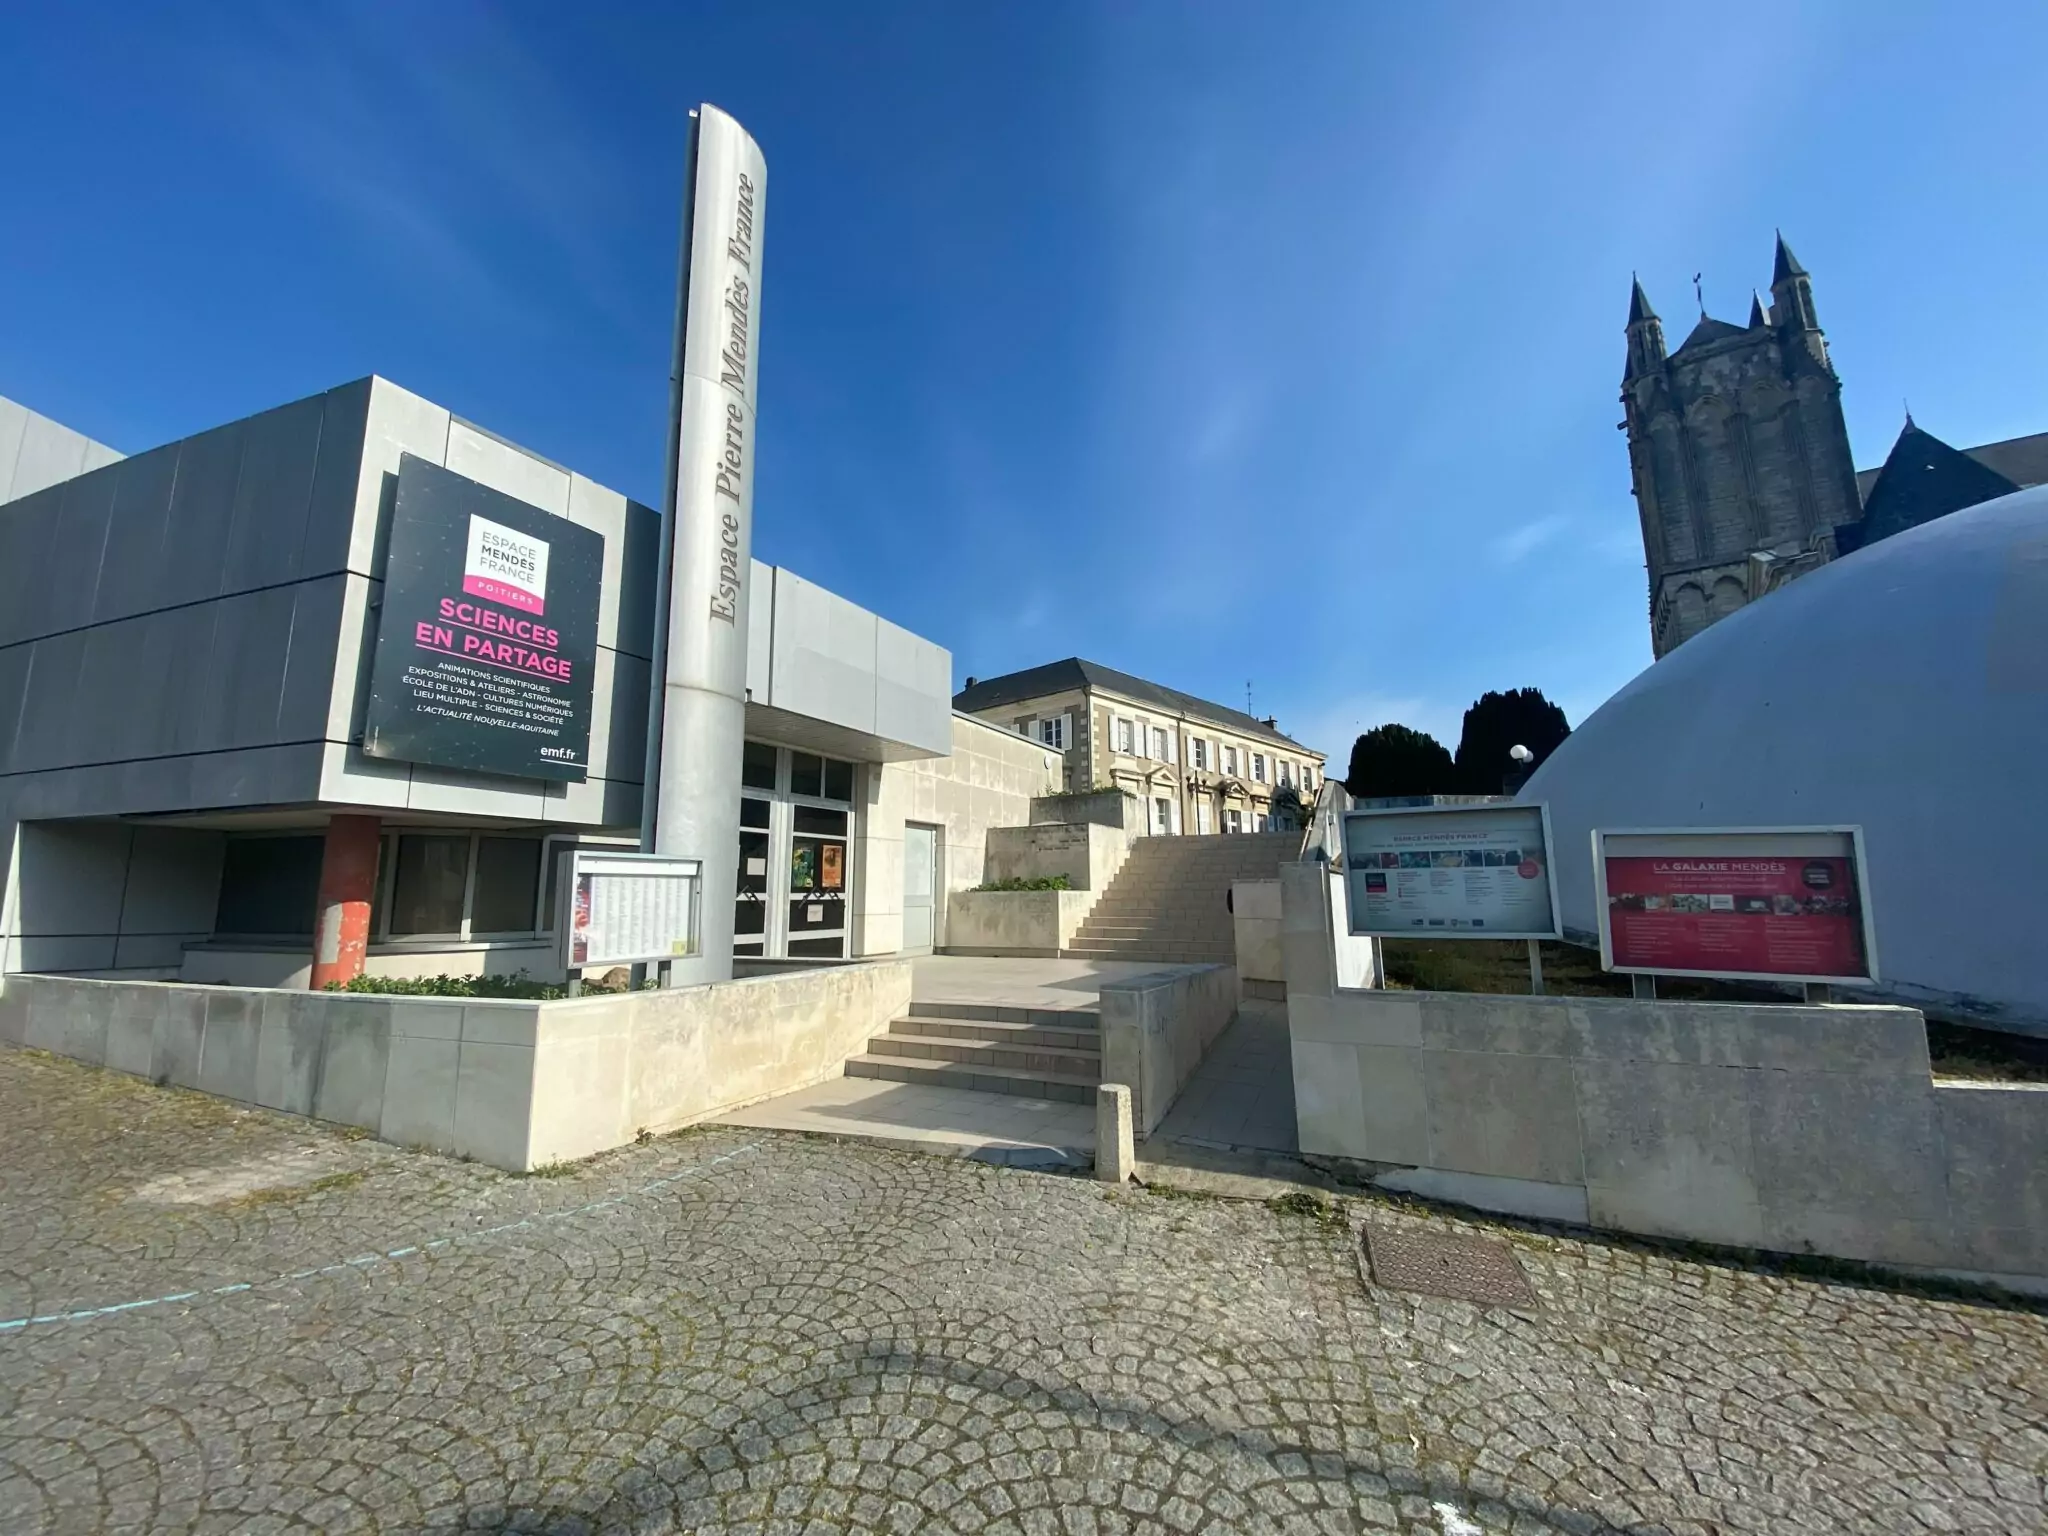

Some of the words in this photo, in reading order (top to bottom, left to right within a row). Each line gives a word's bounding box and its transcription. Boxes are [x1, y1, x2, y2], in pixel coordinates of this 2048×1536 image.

[727, 172, 754, 274] France
[721, 276, 750, 398] Mendès
[716, 403, 744, 506] Pierre
[481, 544, 536, 571] MENDÈS
[482, 531, 537, 560] ESPACE
[479, 556, 536, 584] FRANCE
[710, 513, 741, 628] Espace
[477, 581, 534, 605] POITIERS
[439, 597, 559, 647] SCIENCES
[415, 621, 453, 648] EN
[464, 634, 572, 678] PARTAGE
[408, 666, 468, 685] EXPOSITIONS
[469, 679, 476, 687] &
[477, 681, 516, 695] ATELIERS
[522, 691, 571, 708] ASTRONOMIE
[437, 662, 491, 680] ANIMATIONS
[492, 674, 551, 693] SCIENTIFIQUES
[402, 675, 434, 689] ÉCOLE
[435, 682, 449, 692] DE
[450, 685, 476, 697] L'ADN
[482, 692, 524, 707] CULTURES
[525, 701, 574, 718] NUMÉRIQUES
[413, 689, 435, 699] LIEU
[436, 693, 478, 708] MULTIPLE
[484, 703, 524, 717] SCIENCES
[525, 711, 531, 719] &
[532, 712, 564, 725] SOCIÉTÉ
[416, 704, 473, 721] L'ACTUALITÉ
[473, 714, 560, 737] NOUVELLE-AQUITAINE
[540, 746, 576, 760] emf.fr
[1653, 863, 1669, 871] LA
[1672, 862, 1728, 871] GALAXIE
